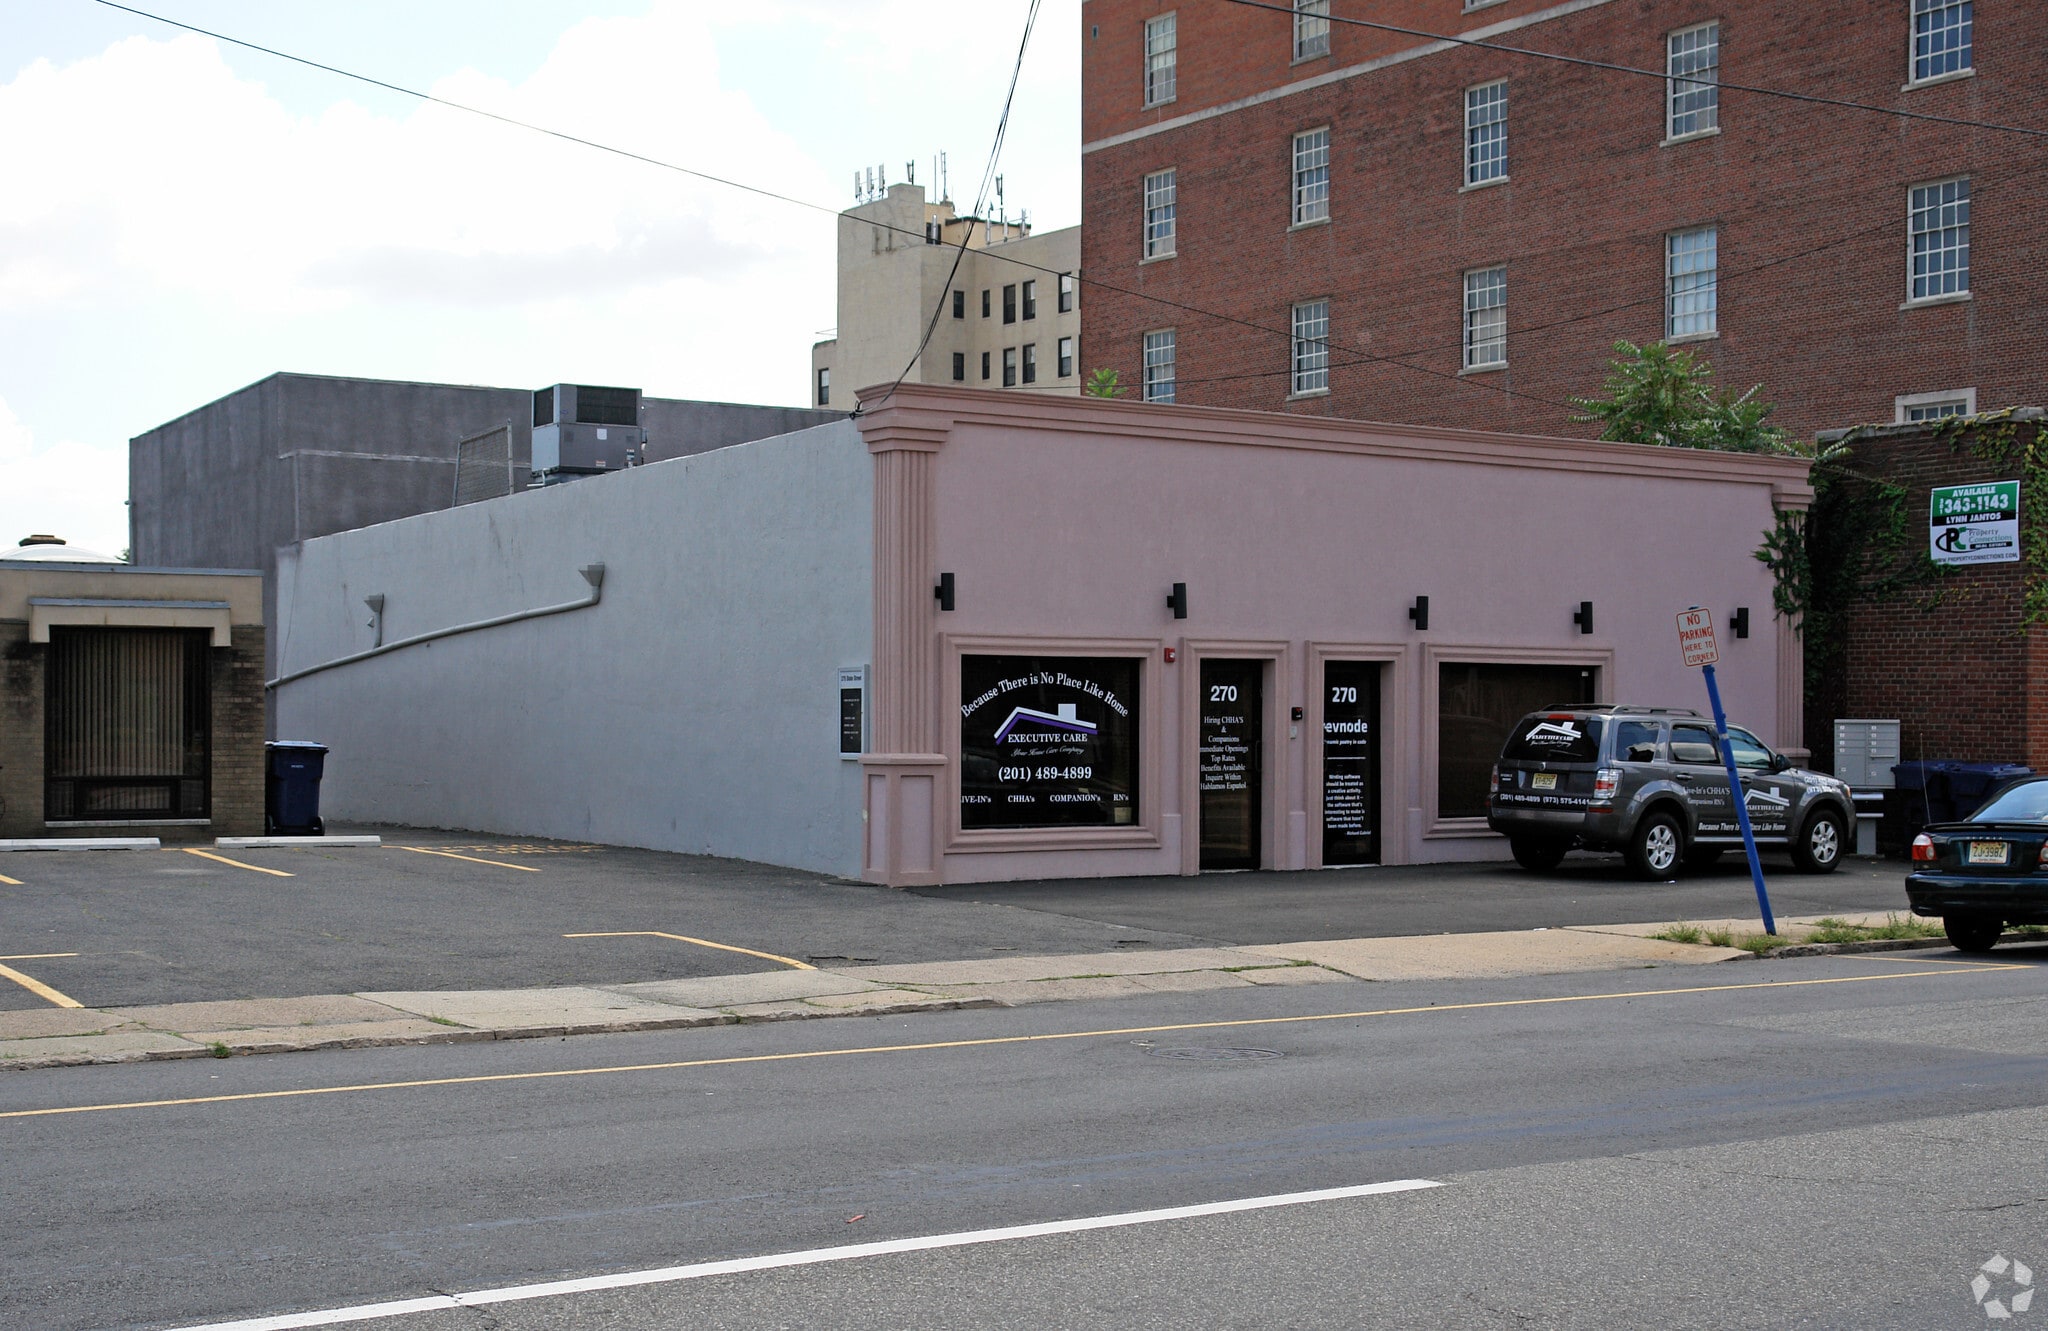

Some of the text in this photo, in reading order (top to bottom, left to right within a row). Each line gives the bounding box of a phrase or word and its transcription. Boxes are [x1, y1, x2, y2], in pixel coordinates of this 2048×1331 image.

[1953, 486, 1996, 497] AVAILABLE
[1945, 494, 2008, 513] 343-1143
[1946, 512, 2001, 524] LYNN JANTOS
[1686, 614, 1700, 625] NO
[1680, 627, 1712, 641] PARKING
[1685, 643, 1702, 652] HERE
[1688, 652, 1715, 663] CORNER
[961, 672, 1129, 718] Because There is No Place Like Home
[1210, 686, 1237, 702] 270
[1332, 687, 1357, 702] 270
[1204, 716, 1221, 725] Hiring
[1008, 734, 1088, 742] EXECUTIVE CARE
[1208, 735, 1240, 744] Companions
[1225, 745, 1248, 753] Openings
[1211, 755, 1221, 763] Top
[998, 767, 1092, 782] (201) 489-4899
[1205, 774, 1224, 782] Inquire
[961, 795, 991, 804] IVE-IN's
[1050, 794, 1100, 802] COMPANION's
[1543, 796, 1559, 804] (973)
[1698, 823, 1720, 831] Because
